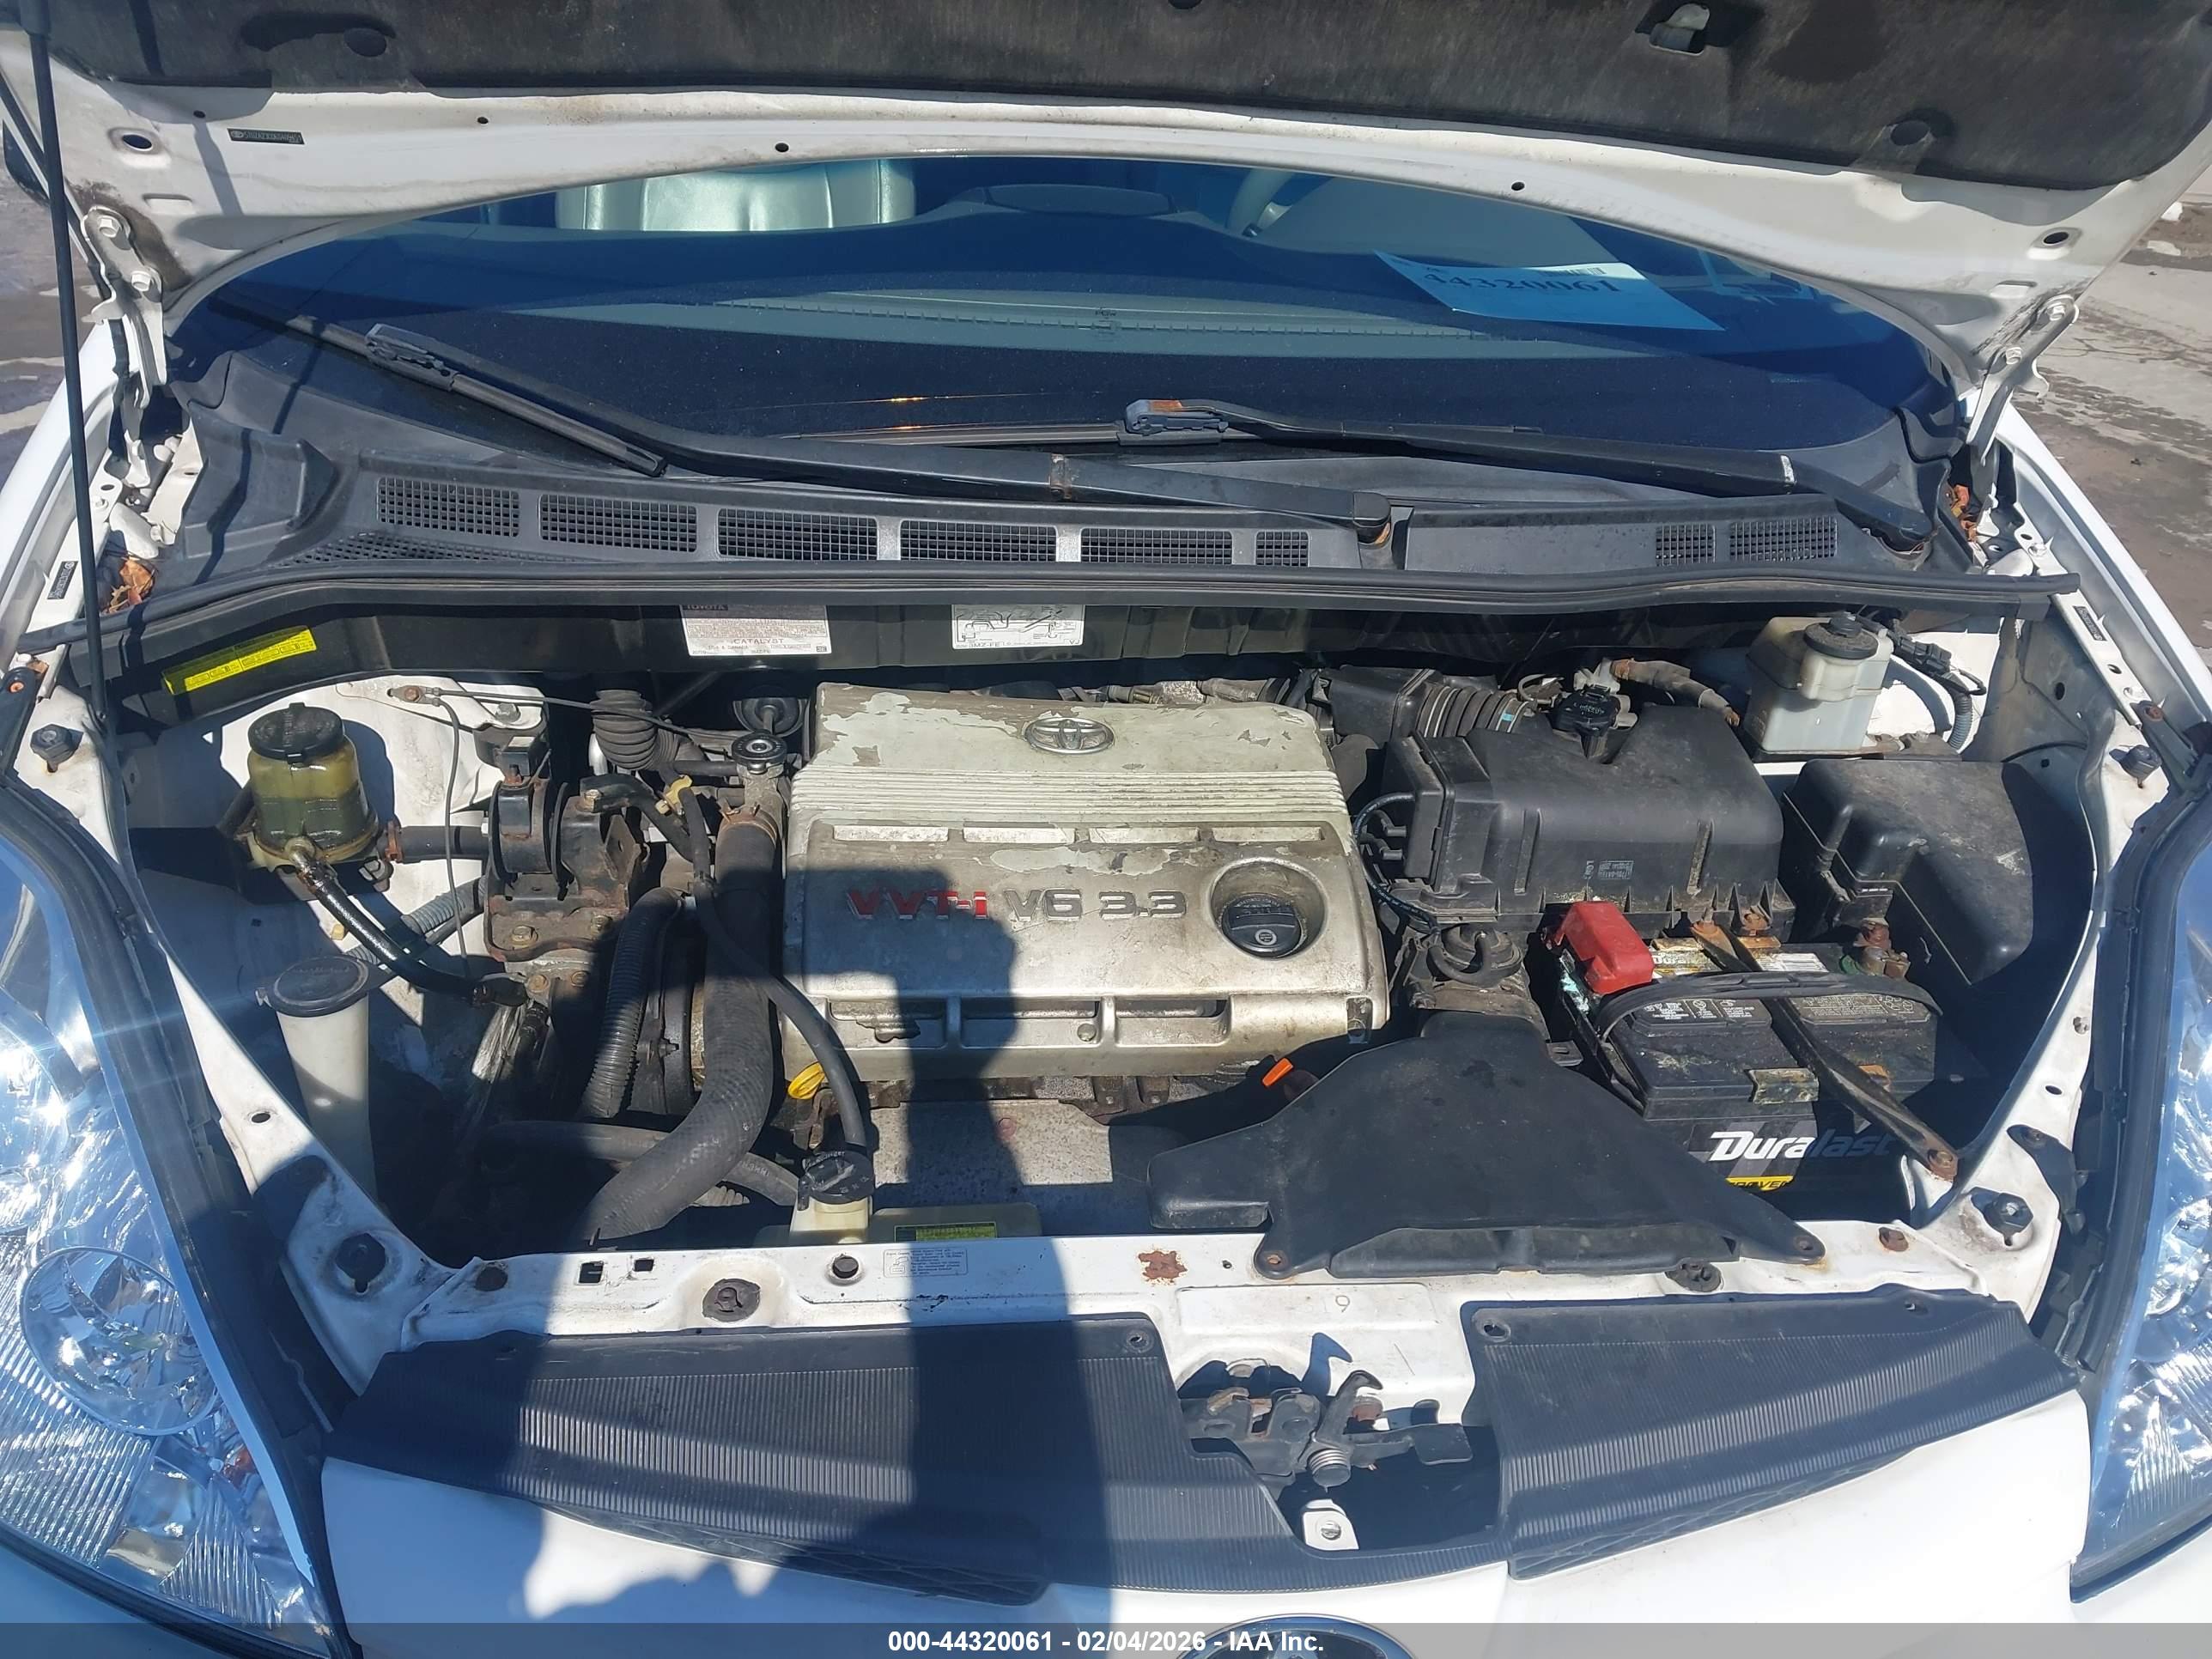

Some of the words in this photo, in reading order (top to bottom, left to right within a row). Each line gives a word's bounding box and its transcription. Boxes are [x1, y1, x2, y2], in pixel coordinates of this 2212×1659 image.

[1423, 273, 1621, 292] 44320061
[1003, 888, 1082, 921] V6
[1098, 890, 1187, 920] 3.3
[1709, 1128, 1893, 1161] Duralast
